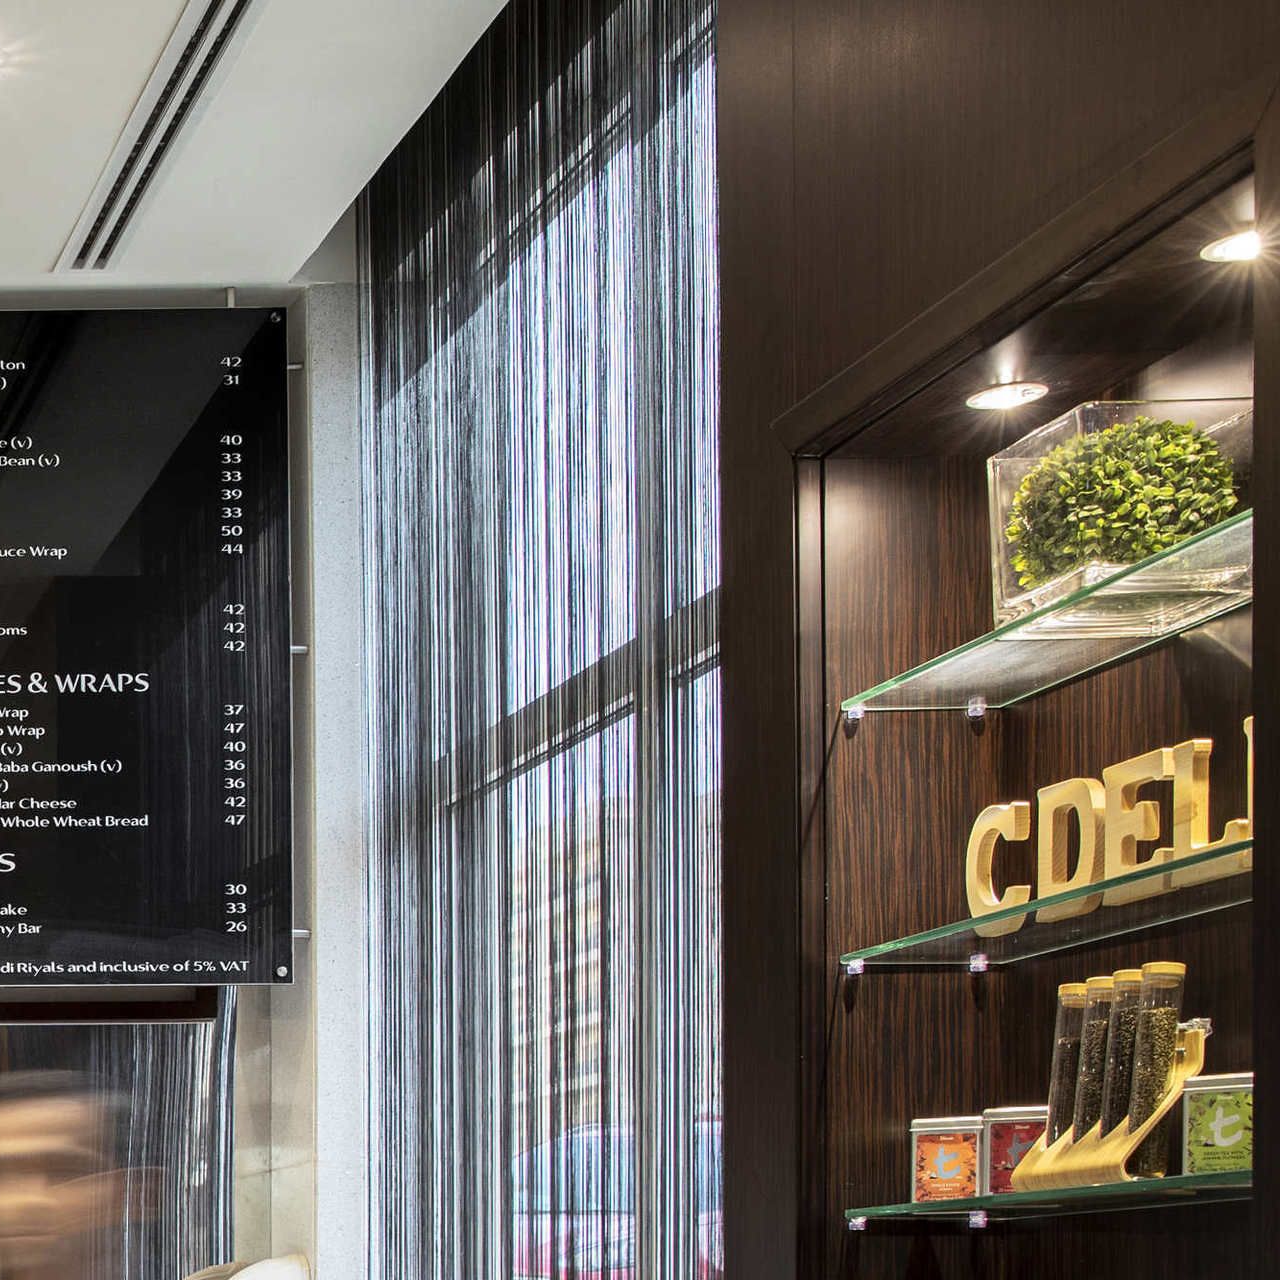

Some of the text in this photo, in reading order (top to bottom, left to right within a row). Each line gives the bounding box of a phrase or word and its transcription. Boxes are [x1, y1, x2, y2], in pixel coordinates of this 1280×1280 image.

[221, 357, 241, 367] 42
[223, 471, 241, 481] 33
[222, 489, 242, 499] 39
[224, 604, 244, 615] 42
[28, 672, 47, 693] &
[55, 673, 149, 693] WRAPS
[7, 726, 45, 739] Wrap
[224, 723, 244, 733] 47
[226, 884, 247, 895] 30
[227, 903, 246, 913] 33
[17, 962, 64, 976] Riyals
[68, 961, 96, 972] and
[100, 961, 169, 972] inclusive
[173, 960, 189, 971] of
[194, 961, 216, 971] 5%
[220, 961, 249, 971] VAT
